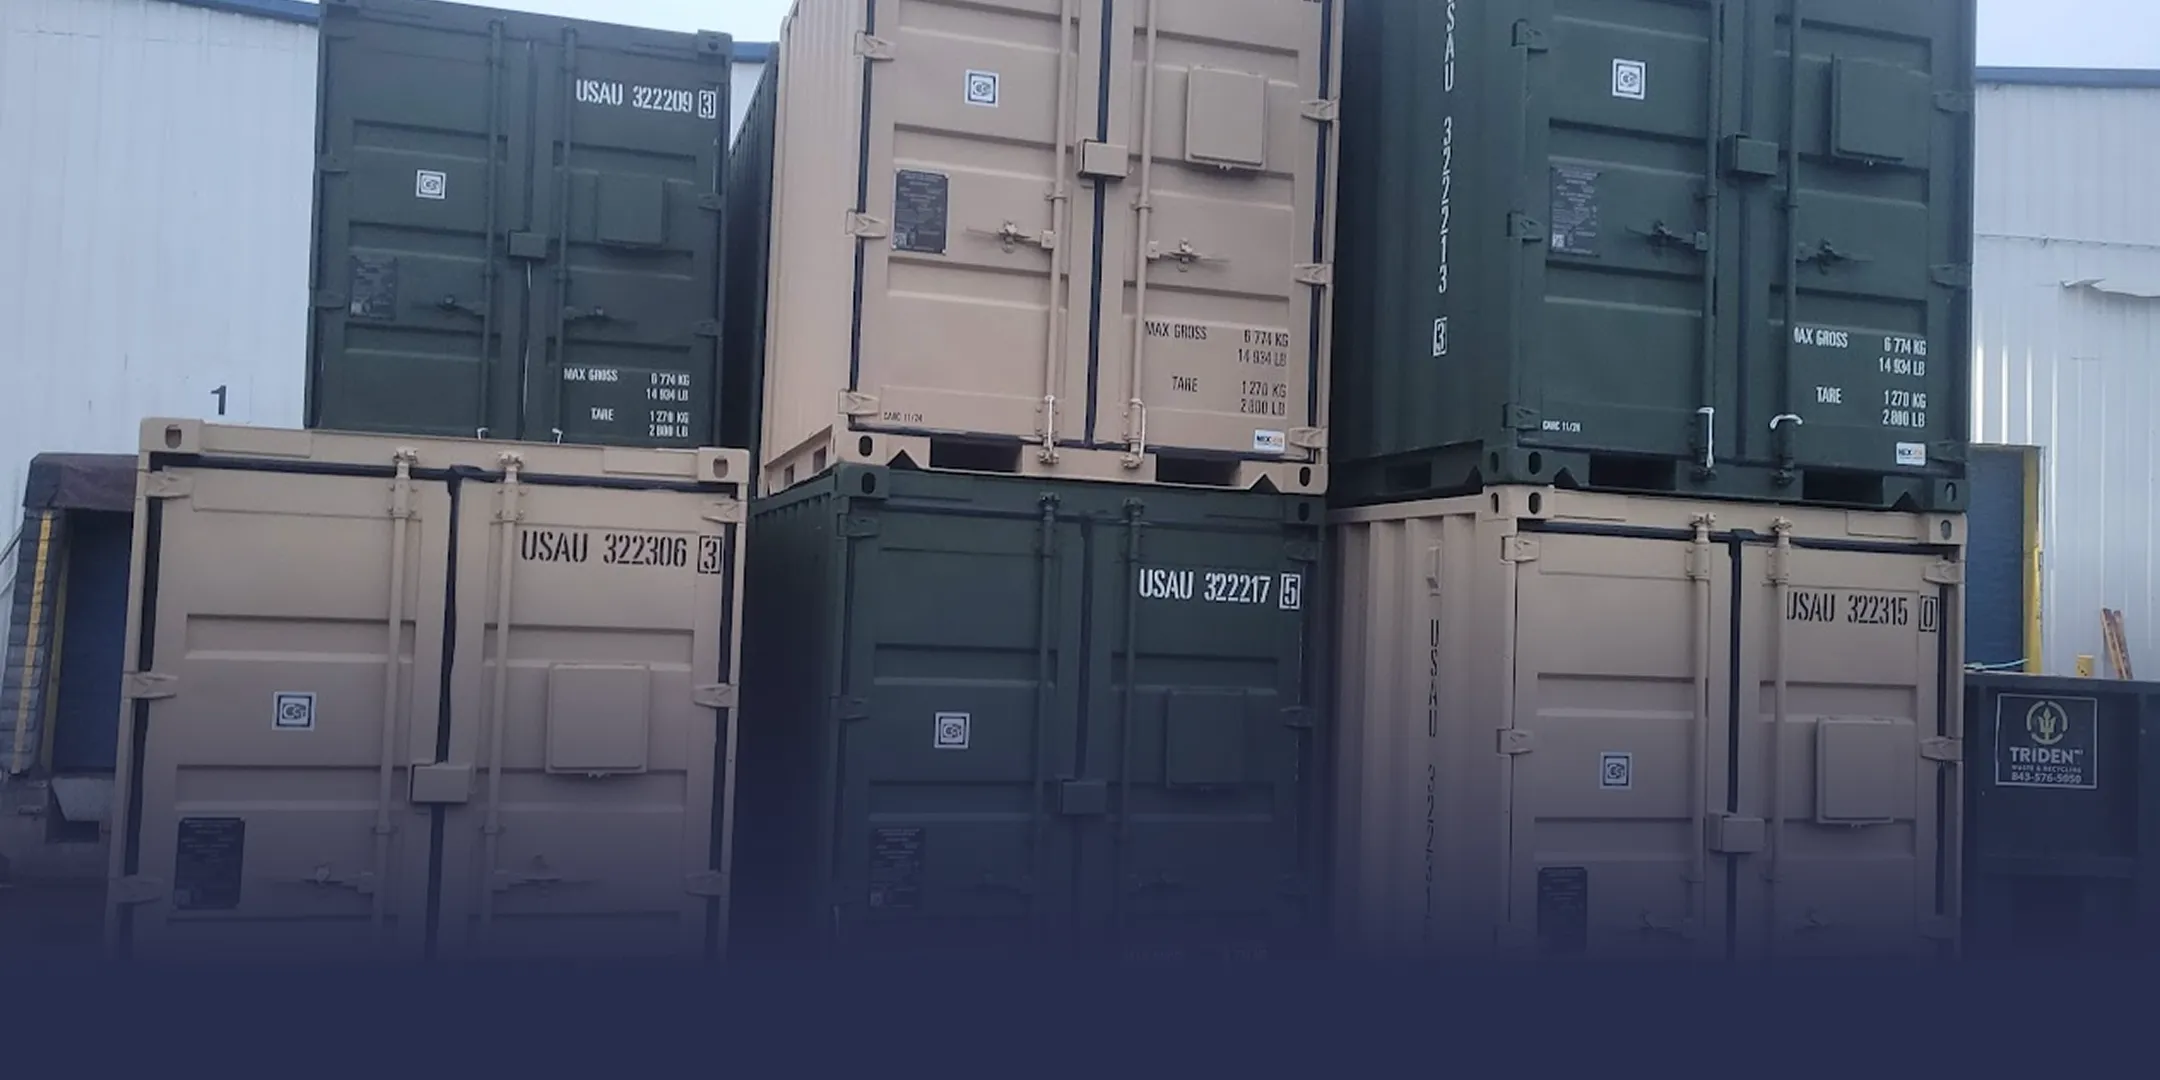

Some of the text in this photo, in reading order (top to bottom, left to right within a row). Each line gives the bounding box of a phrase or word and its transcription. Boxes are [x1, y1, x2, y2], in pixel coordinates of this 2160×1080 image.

[1445, 0, 1455, 92] SAU
[576, 79, 624, 106] USAU
[632, 85, 694, 113] 322209
[1439, 116, 1453, 293] 322213
[1145, 321, 1207, 341] MAX GROSS
[1275, 333, 1289, 348] KG
[1816, 330, 1848, 348] GROSS
[1884, 336, 1926, 356] 6 774 KG
[1238, 348, 1250, 364] 14
[1275, 352, 1287, 367] LB
[1879, 357, 1891, 373] 14
[1913, 361, 1925, 376] LB
[563, 368, 618, 382] MAX GROSS
[678, 374, 690, 387] KG
[1172, 375, 1198, 393] TARE
[1249, 381, 1268, 397] 270
[1272, 383, 1287, 398] KG
[1816, 386, 1842, 404] TARE
[210, 384, 226, 415] 1
[1271, 401, 1285, 416] LB
[1884, 390, 1926, 409] 1 270 KG
[591, 407, 614, 421] TARE
[676, 411, 689, 424] KG
[1882, 409, 1889, 425] 2
[1912, 412, 1925, 428] LB
[521, 530, 588, 563] USAU
[603, 533, 687, 567] 322306
[1139, 568, 1194, 599] USAU
[1204, 572, 1271, 603] 322217
[1787, 591, 1835, 622] USAU
[1847, 594, 1908, 626] 322315
[1428, 619, 1440, 737] USAU
